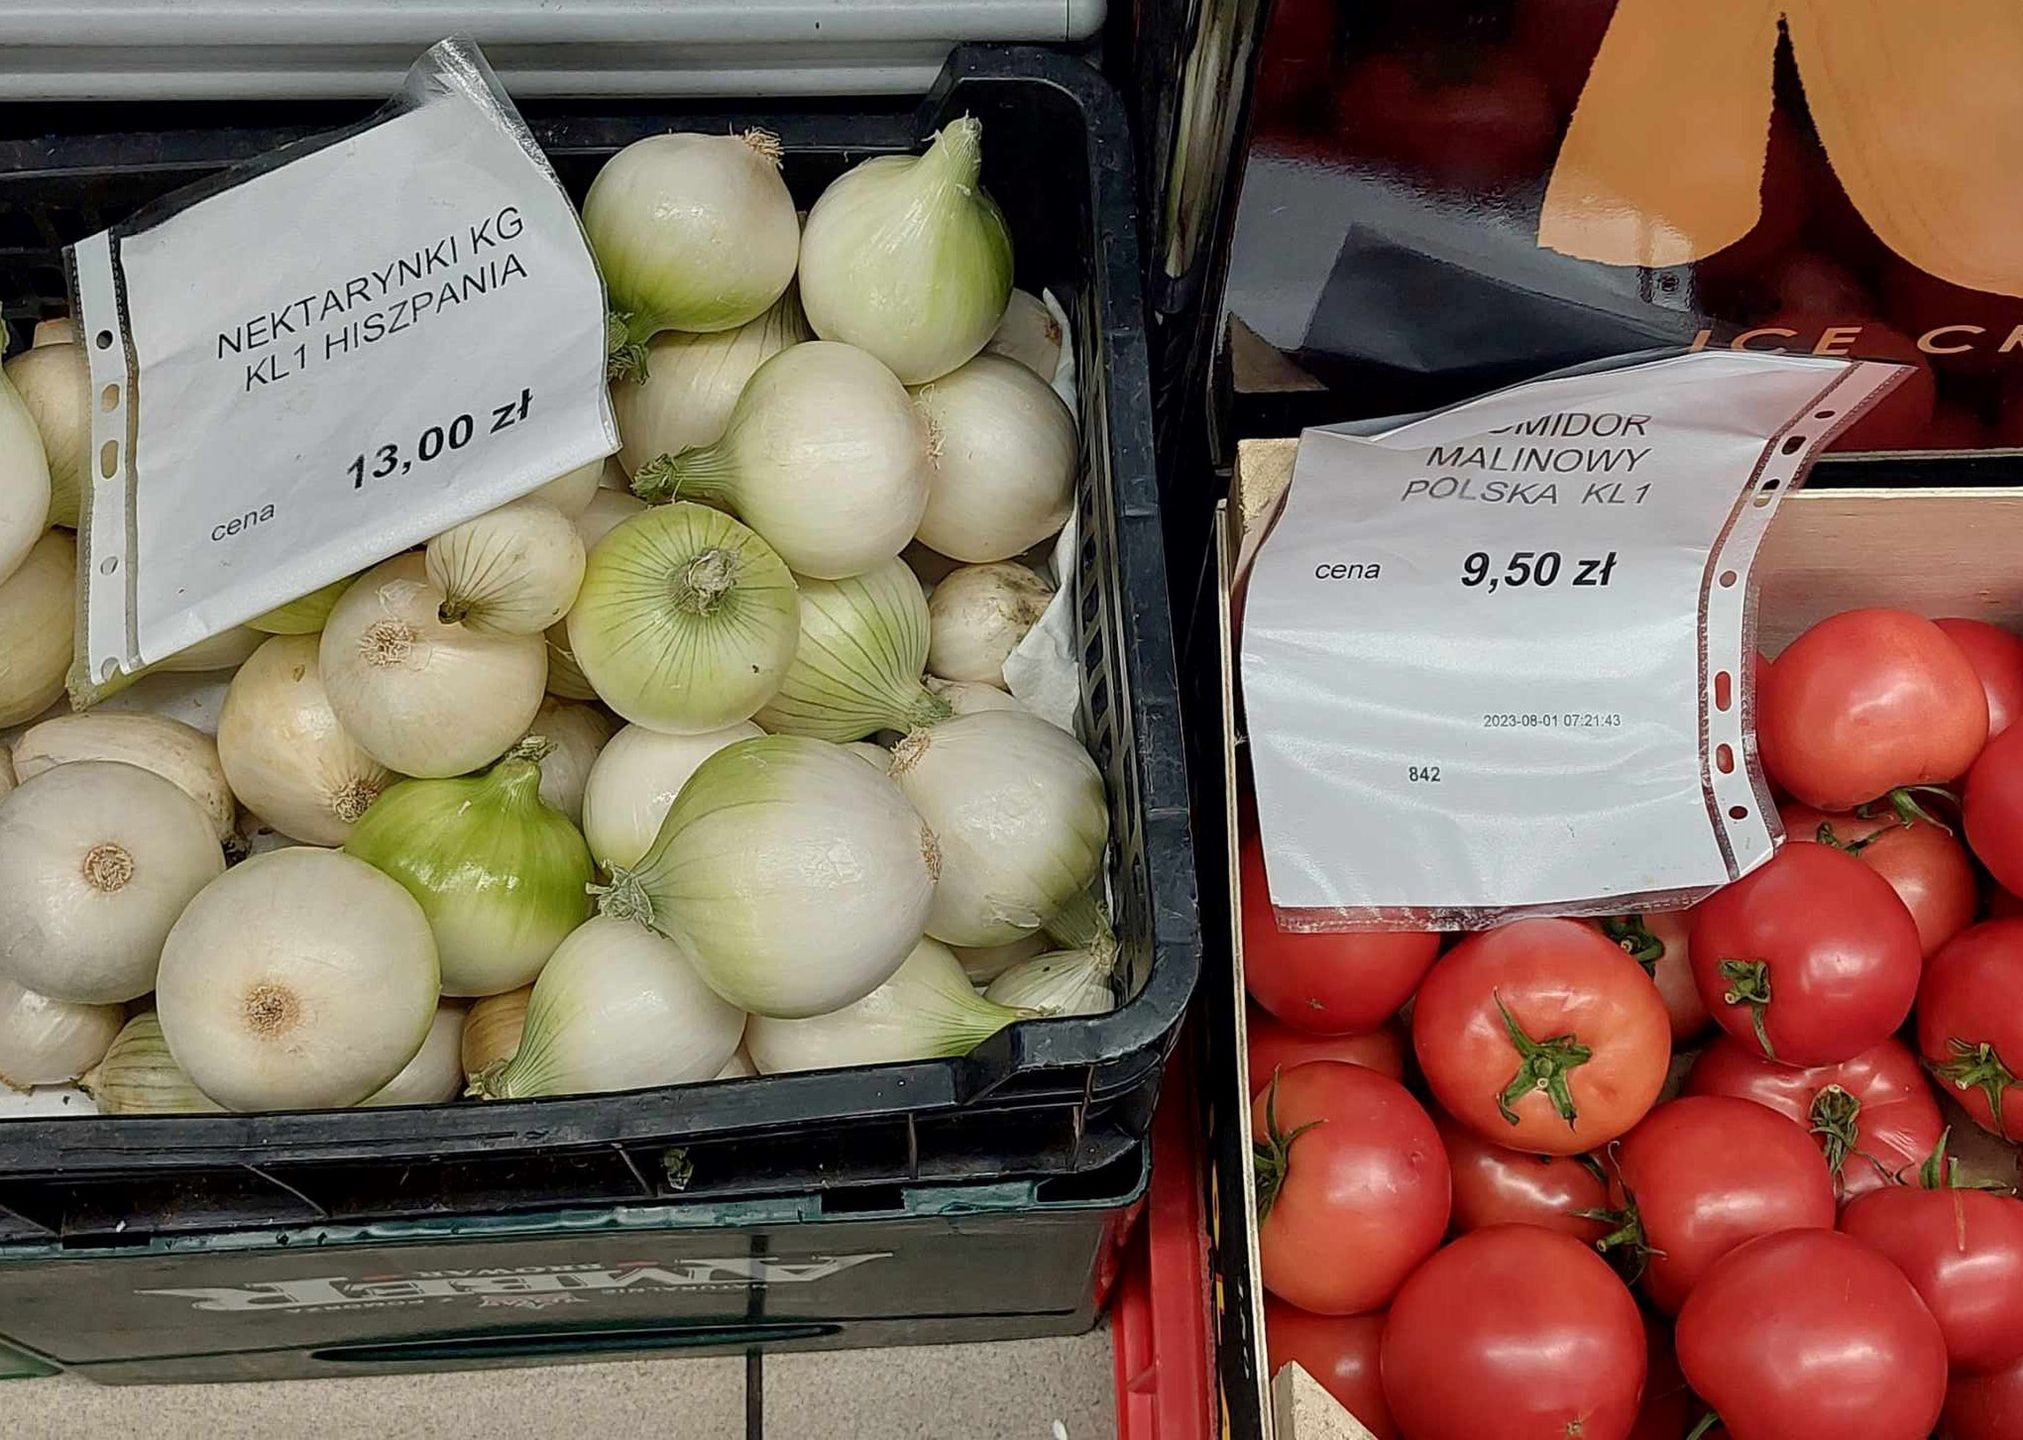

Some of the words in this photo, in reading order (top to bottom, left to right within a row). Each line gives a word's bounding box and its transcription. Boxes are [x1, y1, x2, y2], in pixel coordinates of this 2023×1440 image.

[217, 236, 458, 359] NEKTARYNKI
[470, 206, 524, 254] KG
[245, 344, 306, 392] KL1
[325, 253, 528, 360] HISZPANIA
[1687, 326, 1863, 356] ICE
[1489, 412, 1652, 437] MIDOR
[211, 503, 276, 542] cena
[347, 413, 474, 489] 13,00
[490, 388, 534, 434] zł
[1426, 446, 1652, 472] MALINOWY
[1402, 476, 1557, 504] POLSKA
[1581, 482, 1652, 504] KL1
[1314, 563, 1381, 580] cena
[1460, 551, 1562, 594] 9,50
[1572, 551, 1618, 587] zł
[1483, 713, 1558, 728] 2023-08-01
[1563, 713, 1622, 728] 07:21:43
[1408, 766, 1441, 782] 842
